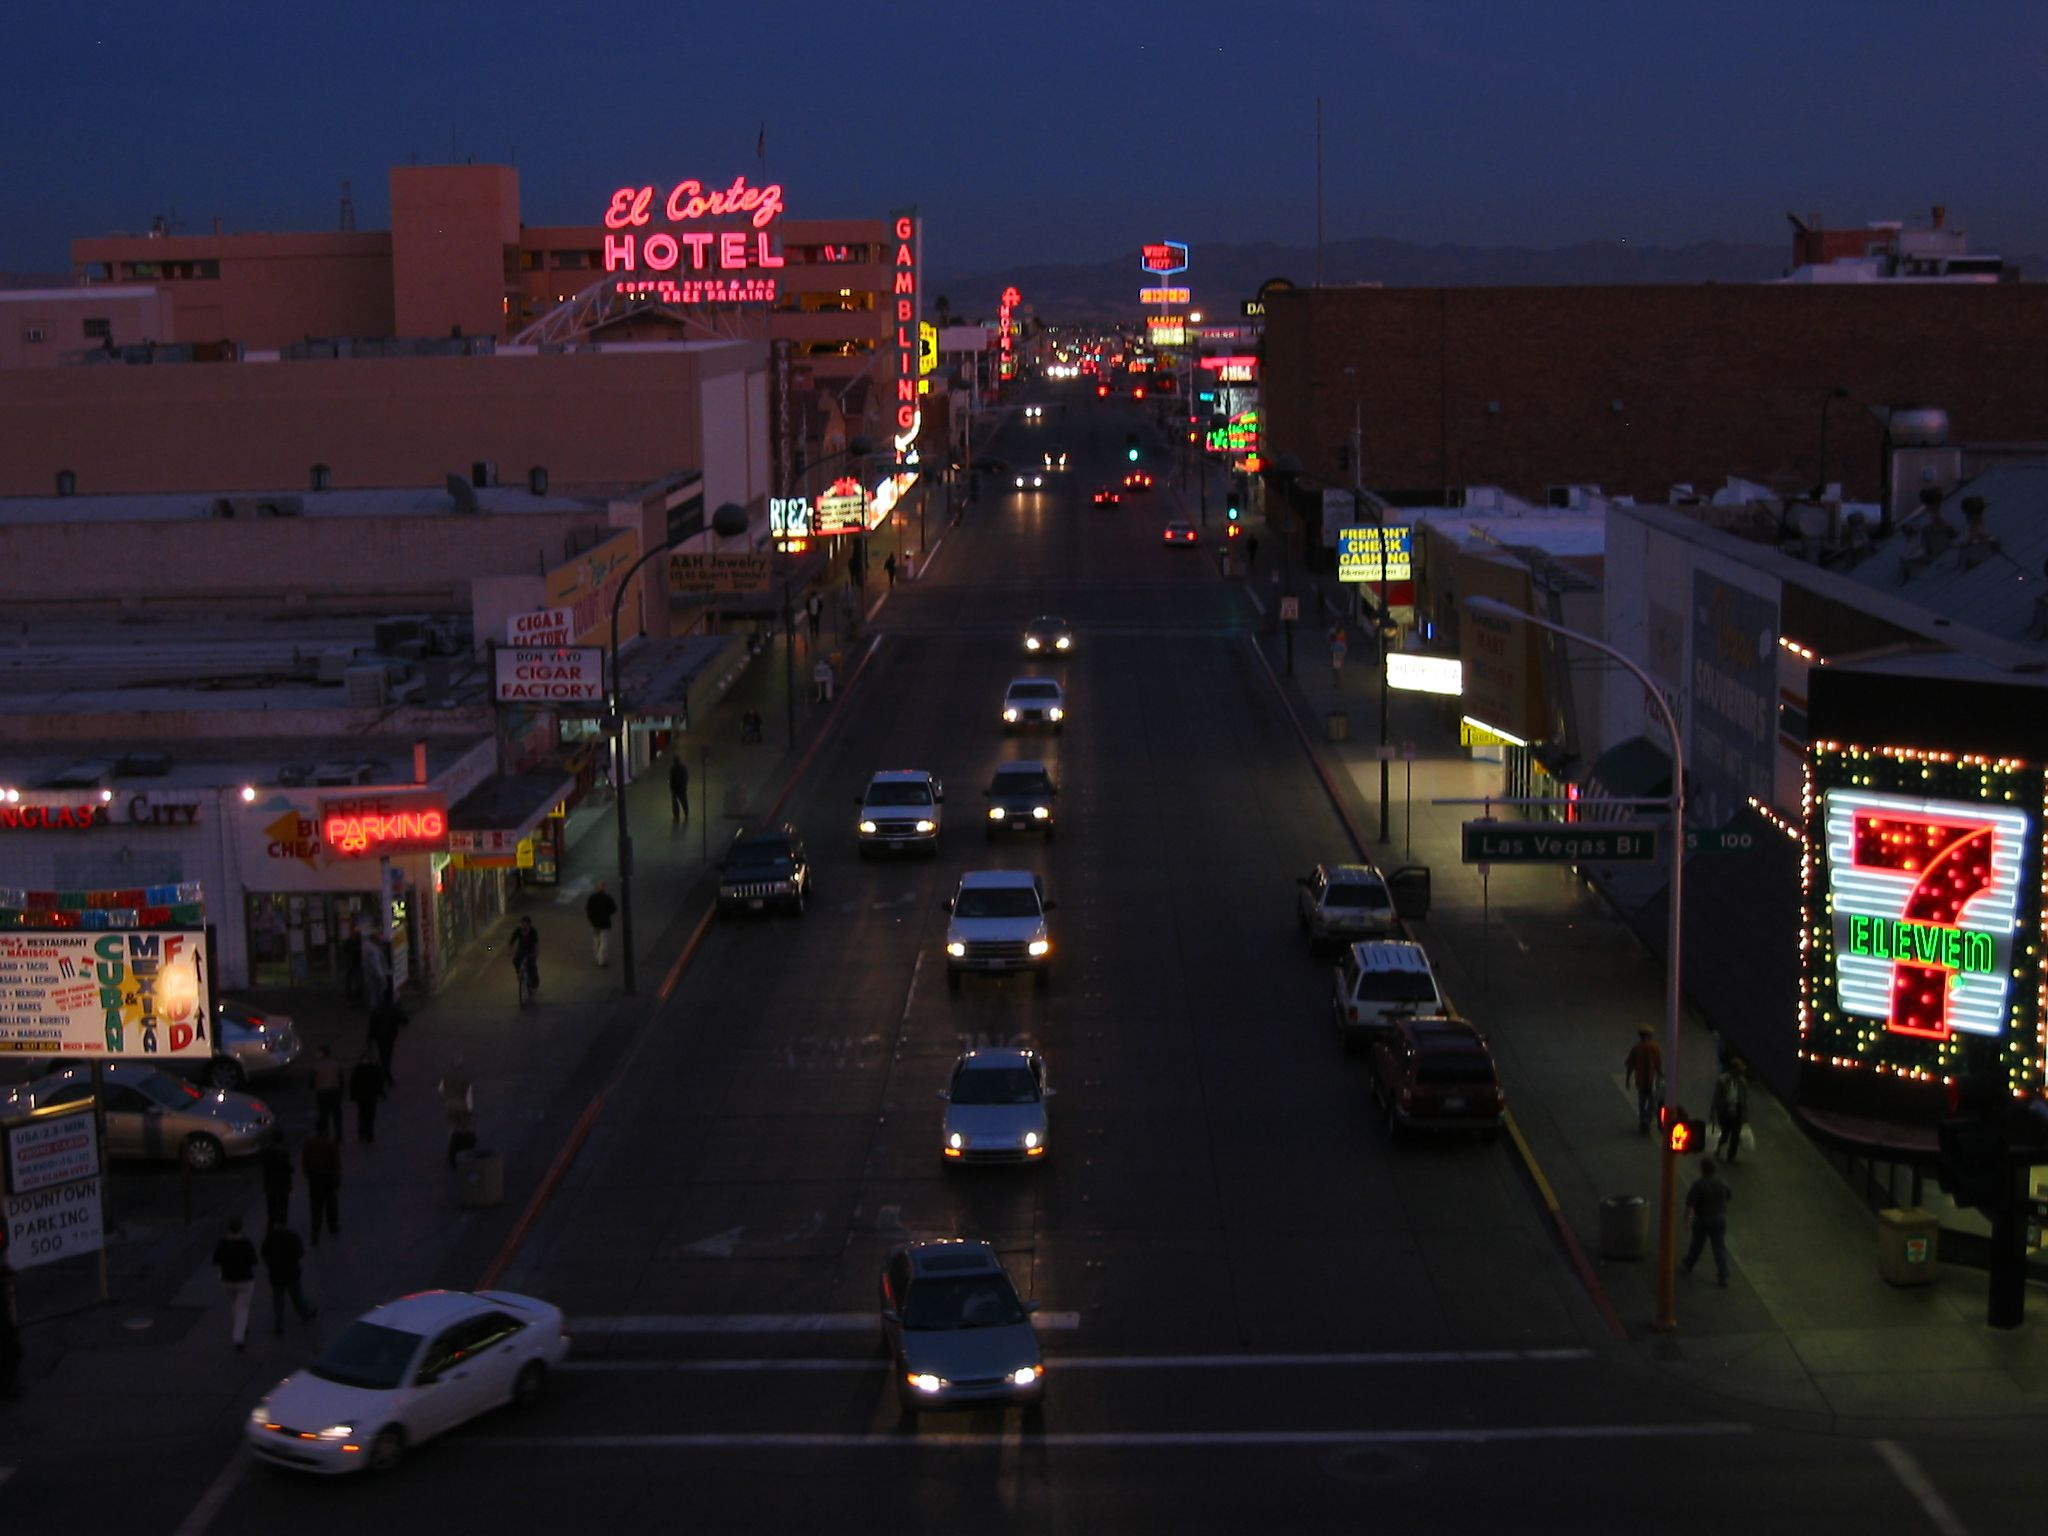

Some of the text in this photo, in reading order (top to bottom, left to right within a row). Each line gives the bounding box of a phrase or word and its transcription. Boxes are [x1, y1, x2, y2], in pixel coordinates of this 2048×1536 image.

[604, 176, 783, 228] El Cortez
[604, 232, 784, 271] HOTEL
[616, 282, 675, 293] COFFEE
[684, 280, 723, 290] SHOP
[747, 279, 775, 289] BAR
[663, 290, 775, 303] FREE PARKING
[896, 217, 913, 427] GAMBLING
[1347, 540, 1401, 552] CHEK
[1339, 553, 1410, 565] CASHNG
[516, 611, 564, 632] CIGAR
[513, 629, 569, 647] FACTORY
[516, 651, 543, 662] DON
[515, 666, 581, 680] CIGAR
[501, 684, 596, 697] FACTORY
[328, 811, 443, 845] PARKING
[1482, 837, 1523, 854] Las
[1534, 836, 1606, 858] Vegas
[1721, 834, 1751, 848] 100
[164, 935, 193, 1052] FOD
[9, 1181, 96, 1217] DOWNTOWN
